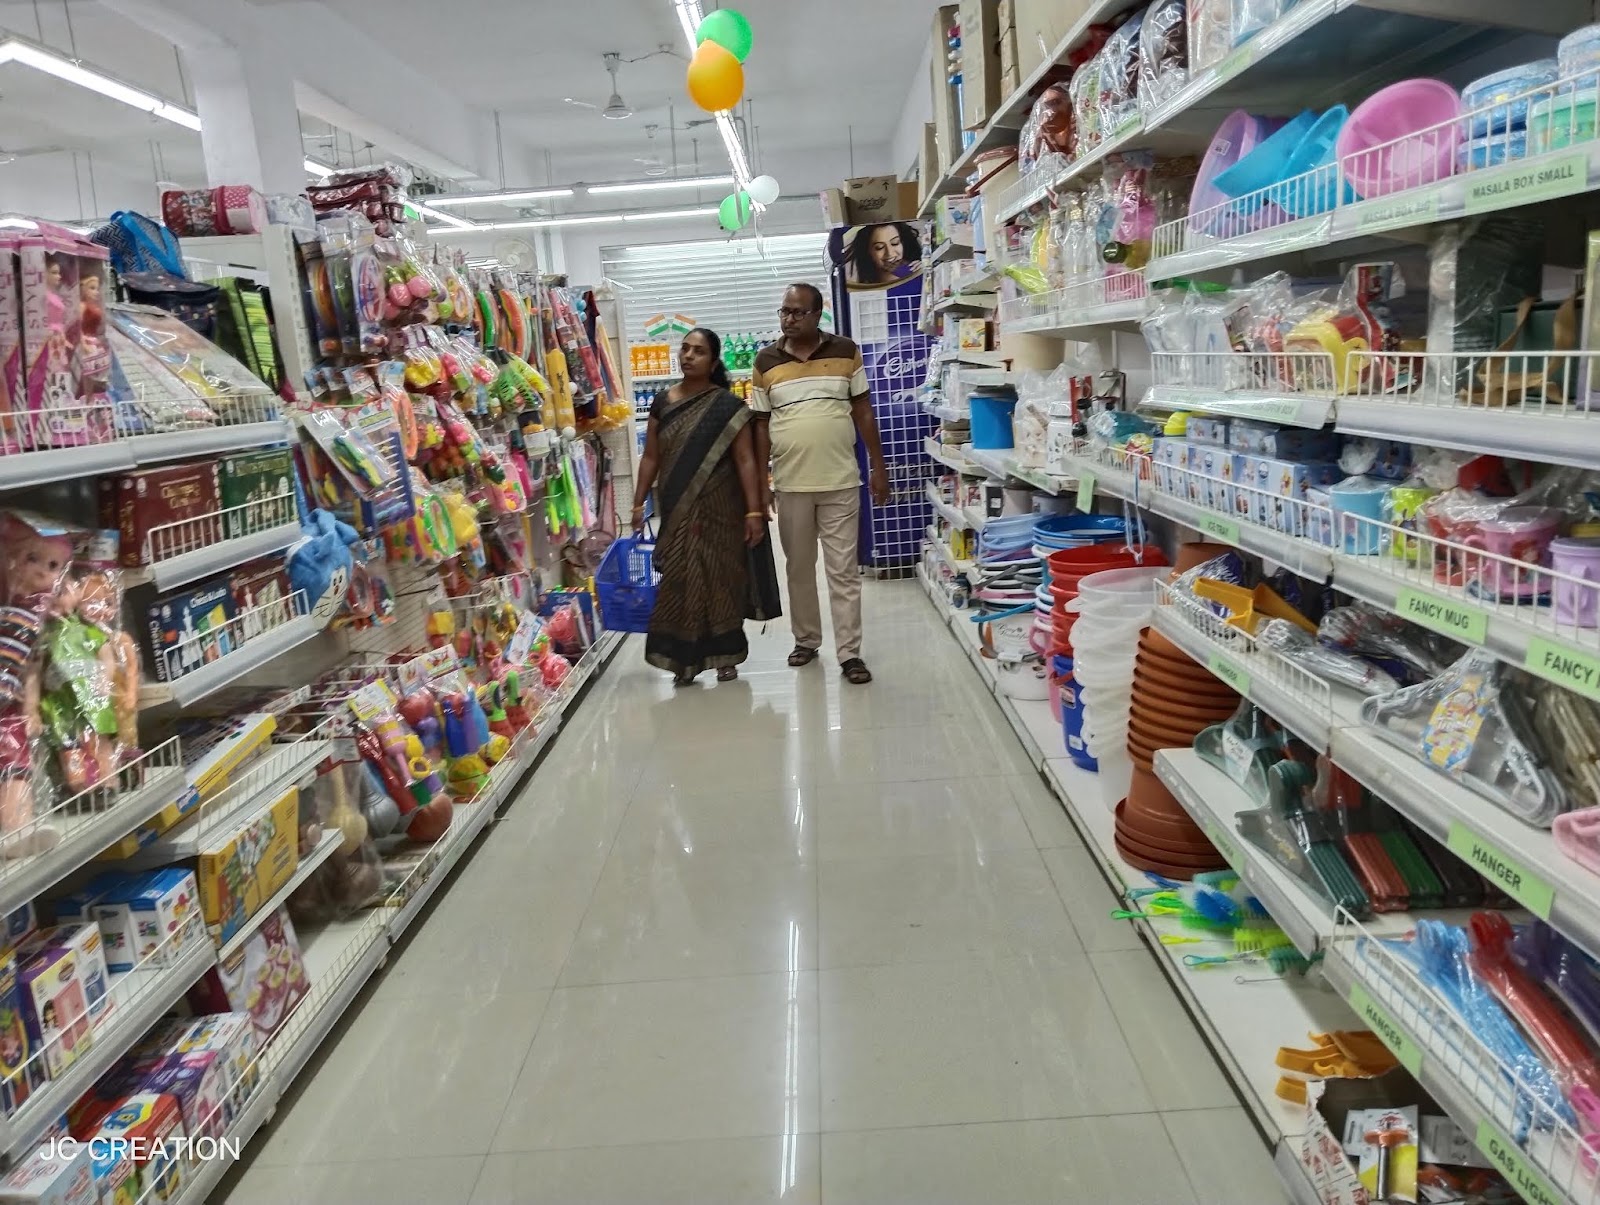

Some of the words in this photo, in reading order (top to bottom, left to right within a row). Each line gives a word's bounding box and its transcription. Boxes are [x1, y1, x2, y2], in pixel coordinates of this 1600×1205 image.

[1472, 181, 1510, 199] MASALA
[1513, 174, 1535, 190] BOX
[1537, 164, 1574, 184] SMALL
[1408, 598, 1443, 619] FANCY
[1444, 608, 1469, 629] MUG
[1544, 651, 1594, 684] FANCY
[1471, 844, 1522, 892] HANGER
[1365, 1004, 1402, 1051] HANGER
[1489, 1139, 1515, 1173] GAS
